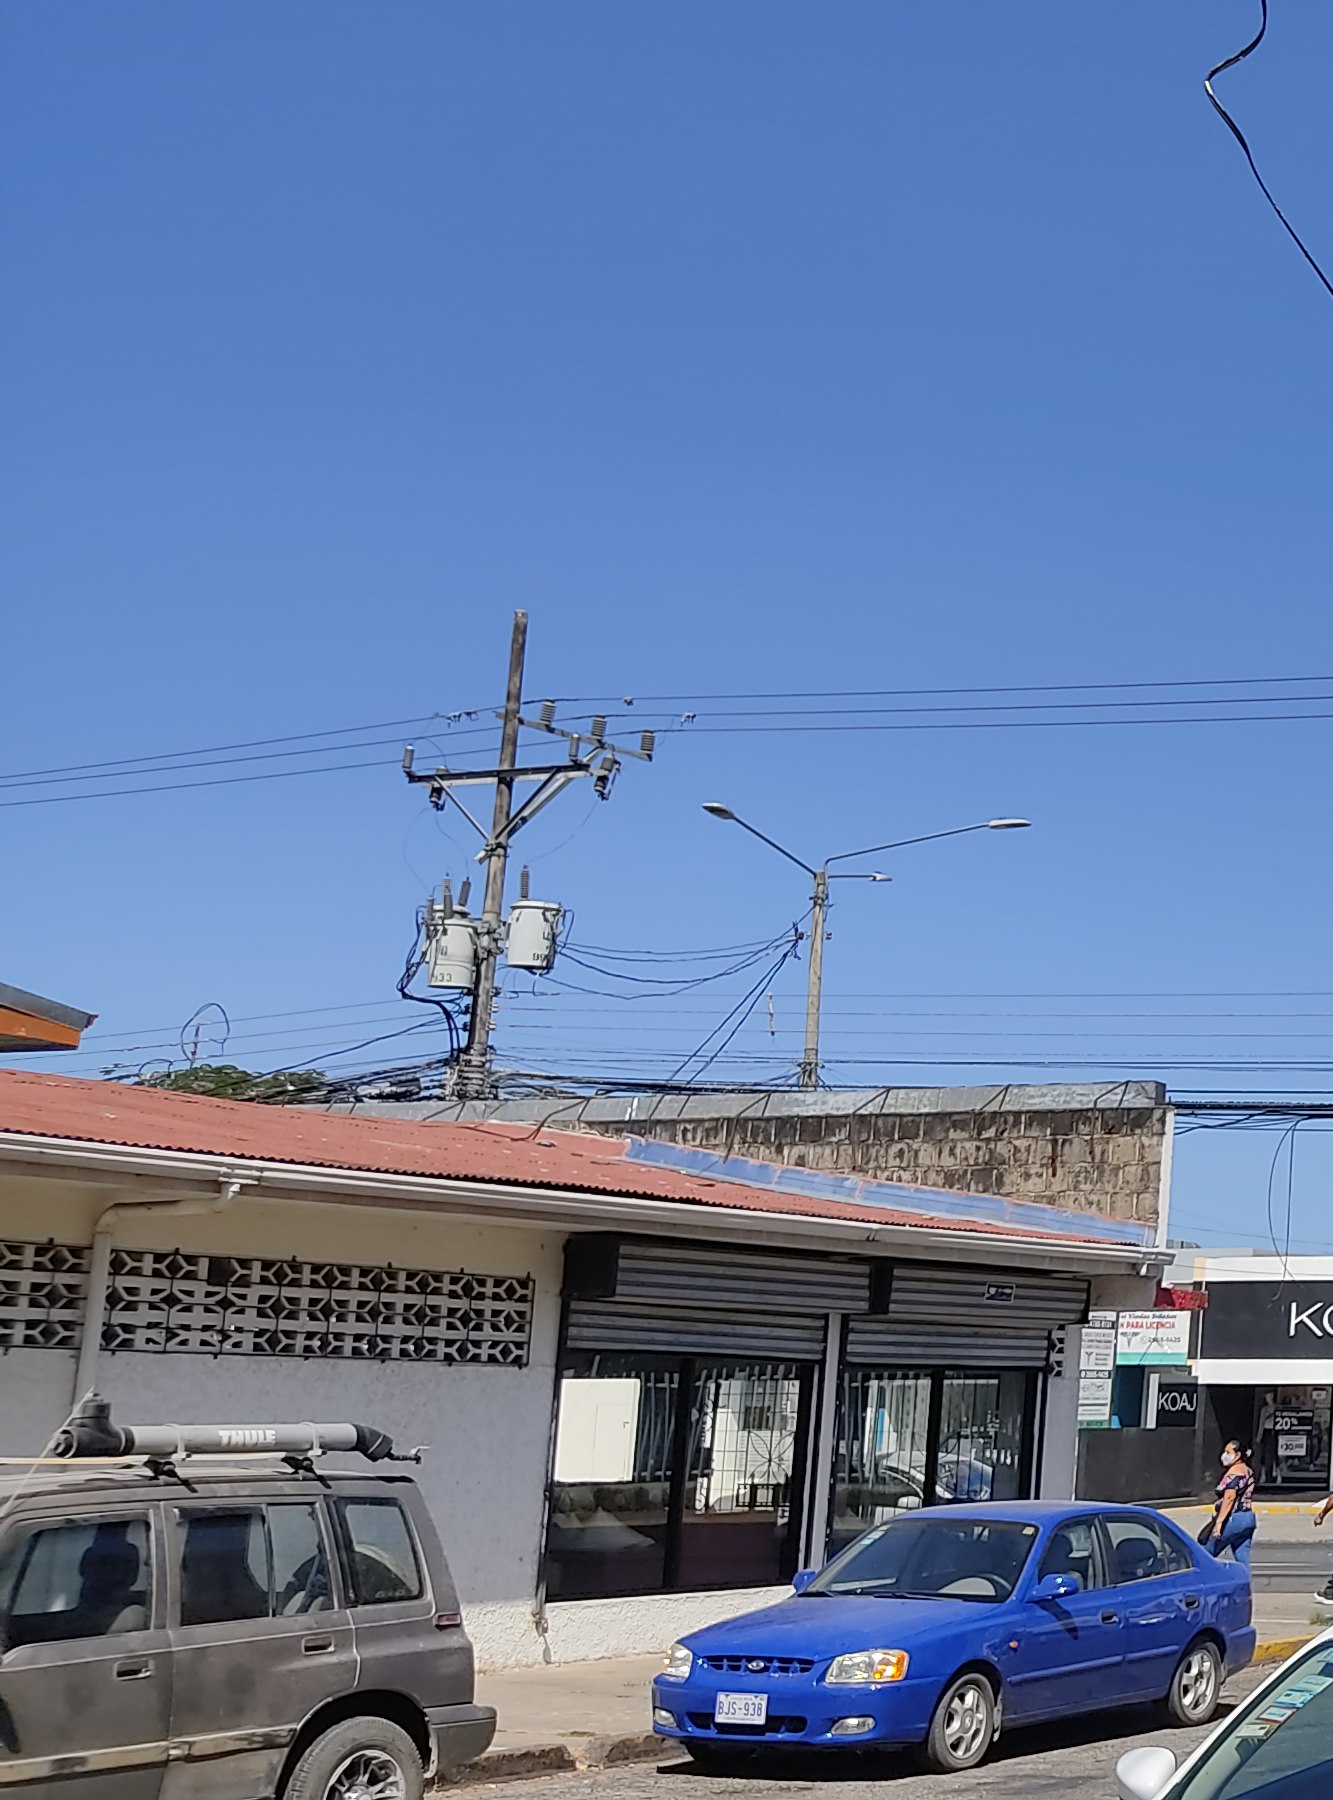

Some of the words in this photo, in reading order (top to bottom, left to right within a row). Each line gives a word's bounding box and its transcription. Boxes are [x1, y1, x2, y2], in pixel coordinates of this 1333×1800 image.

[1126, 1321, 1144, 1329] PARA
[1145, 1321, 1176, 1329] LICENCIA
[1158, 1391, 1197, 1412] KOAJ
[218, 1429, 277, 1448] THULE
[718, 1700, 763, 1717] BJS-938
